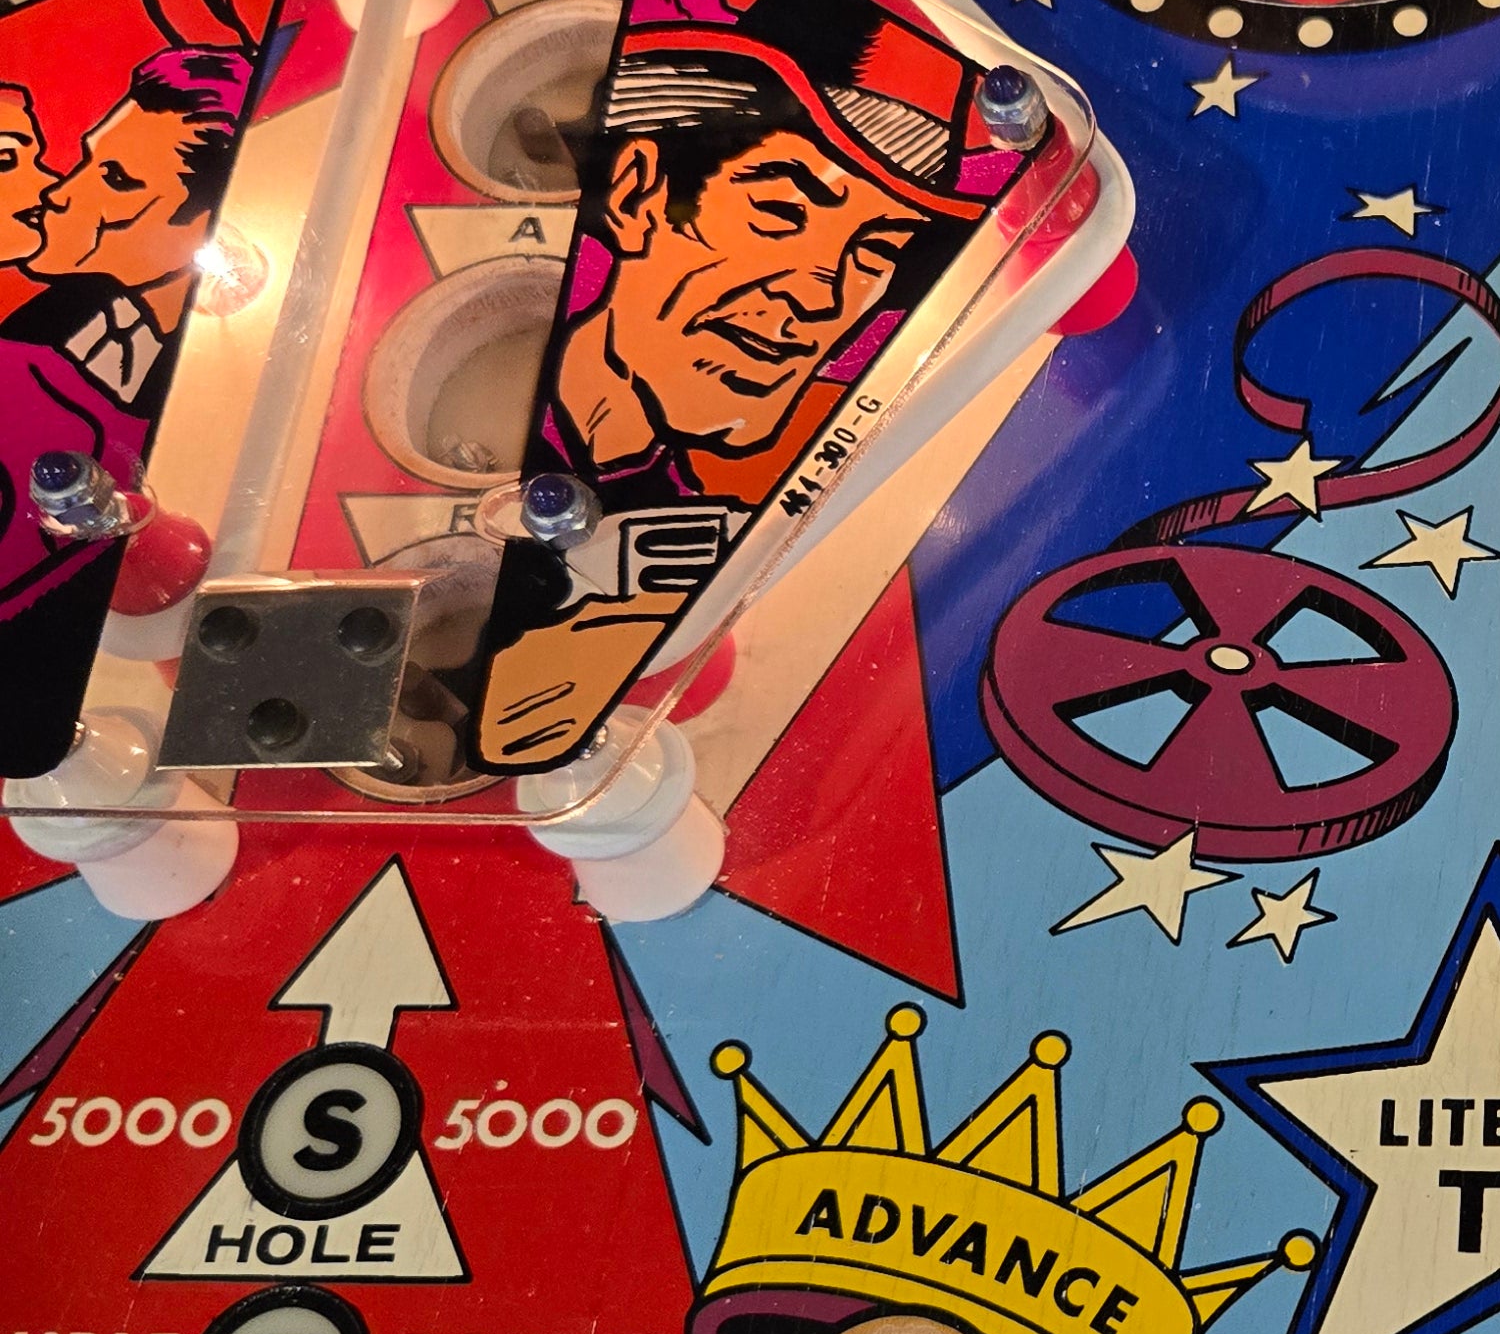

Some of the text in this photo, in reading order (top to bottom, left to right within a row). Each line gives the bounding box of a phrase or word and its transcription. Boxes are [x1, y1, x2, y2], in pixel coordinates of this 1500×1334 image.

[507, 216, 547, 245] A
[29, 1096, 639, 1149] 5000 5000
[292, 1088, 367, 1172] S
[203, 1223, 402, 1264] HOLE
